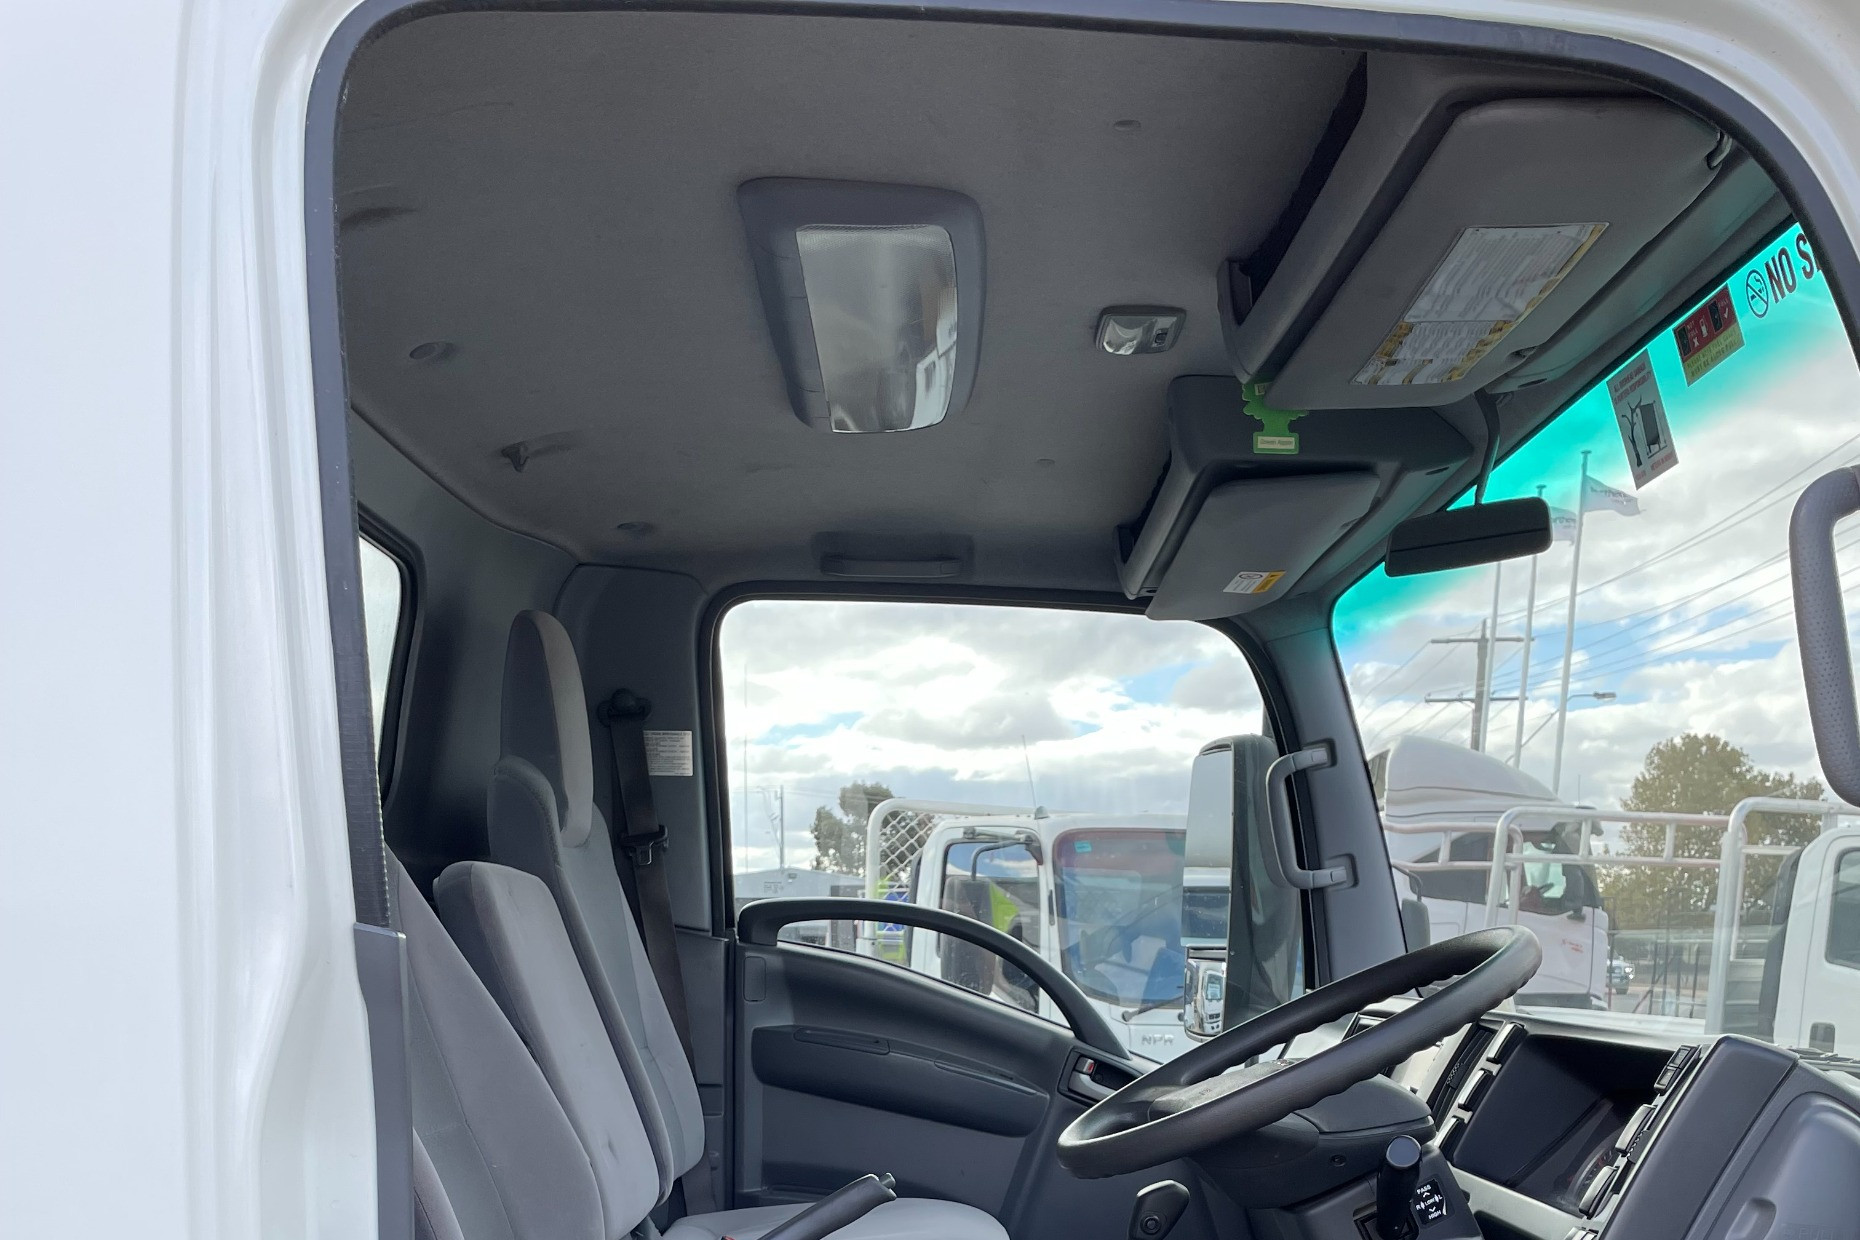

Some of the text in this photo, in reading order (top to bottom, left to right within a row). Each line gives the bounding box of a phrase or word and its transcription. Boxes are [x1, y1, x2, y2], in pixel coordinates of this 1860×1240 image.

[1764, 246, 1797, 304] NO
[1141, 1034, 1174, 1046] NPR
[1416, 1184, 1432, 1195] PASS
[1428, 1210, 1442, 1220] HIGH
